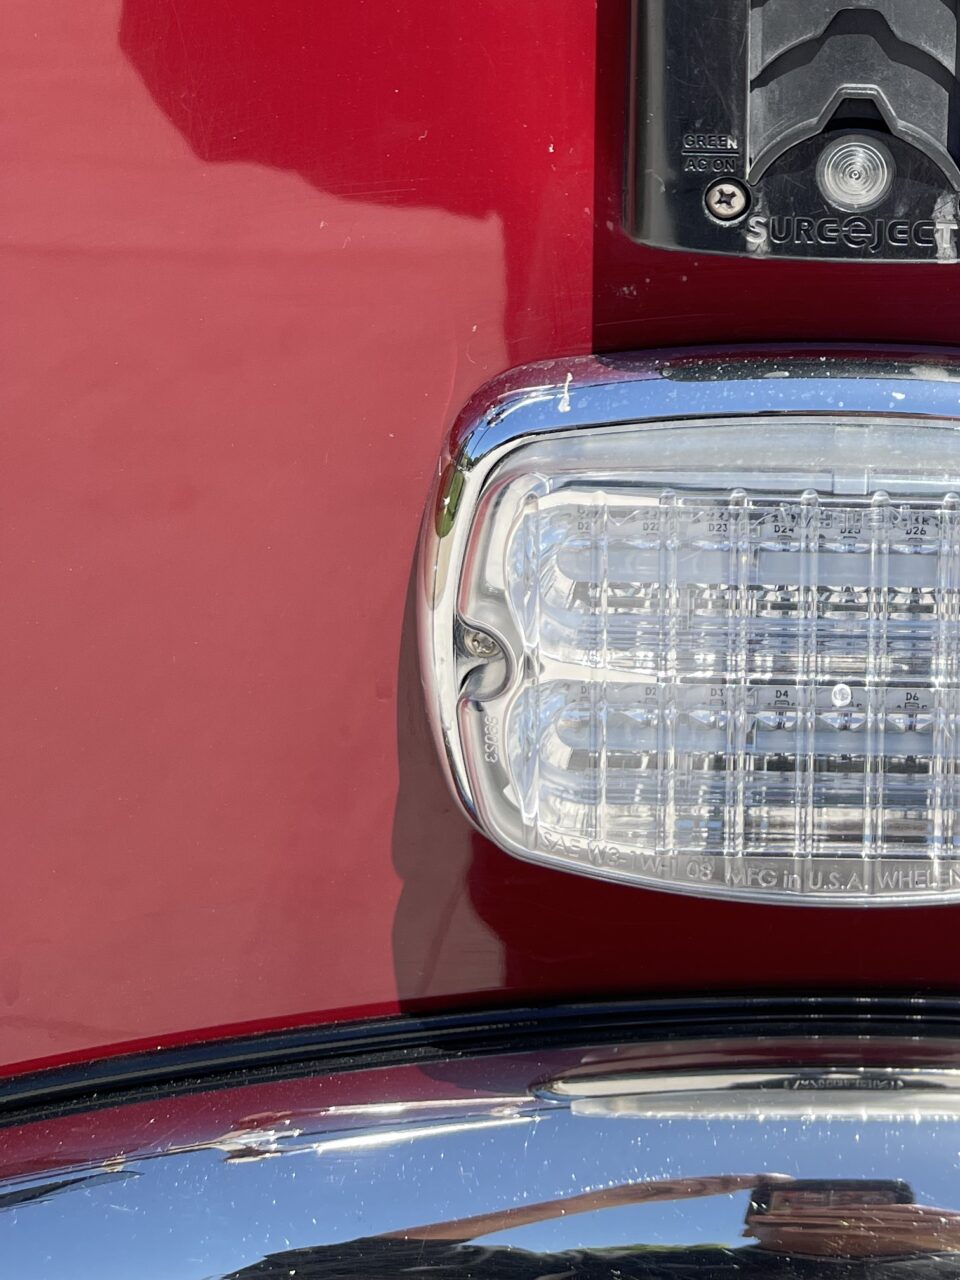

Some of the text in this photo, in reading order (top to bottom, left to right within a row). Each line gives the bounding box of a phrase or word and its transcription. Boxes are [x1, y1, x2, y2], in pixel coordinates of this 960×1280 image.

[683, 133, 739, 149] GREEN
[684, 158, 736, 173] AC ON
[710, 688, 724, 698] D3
[775, 689, 789, 699] D4
[905, 692, 920, 702] D6
[725, 867, 778, 888] MFG
[783, 870, 801, 888] in
[808, 870, 869, 891] U.S.A.
